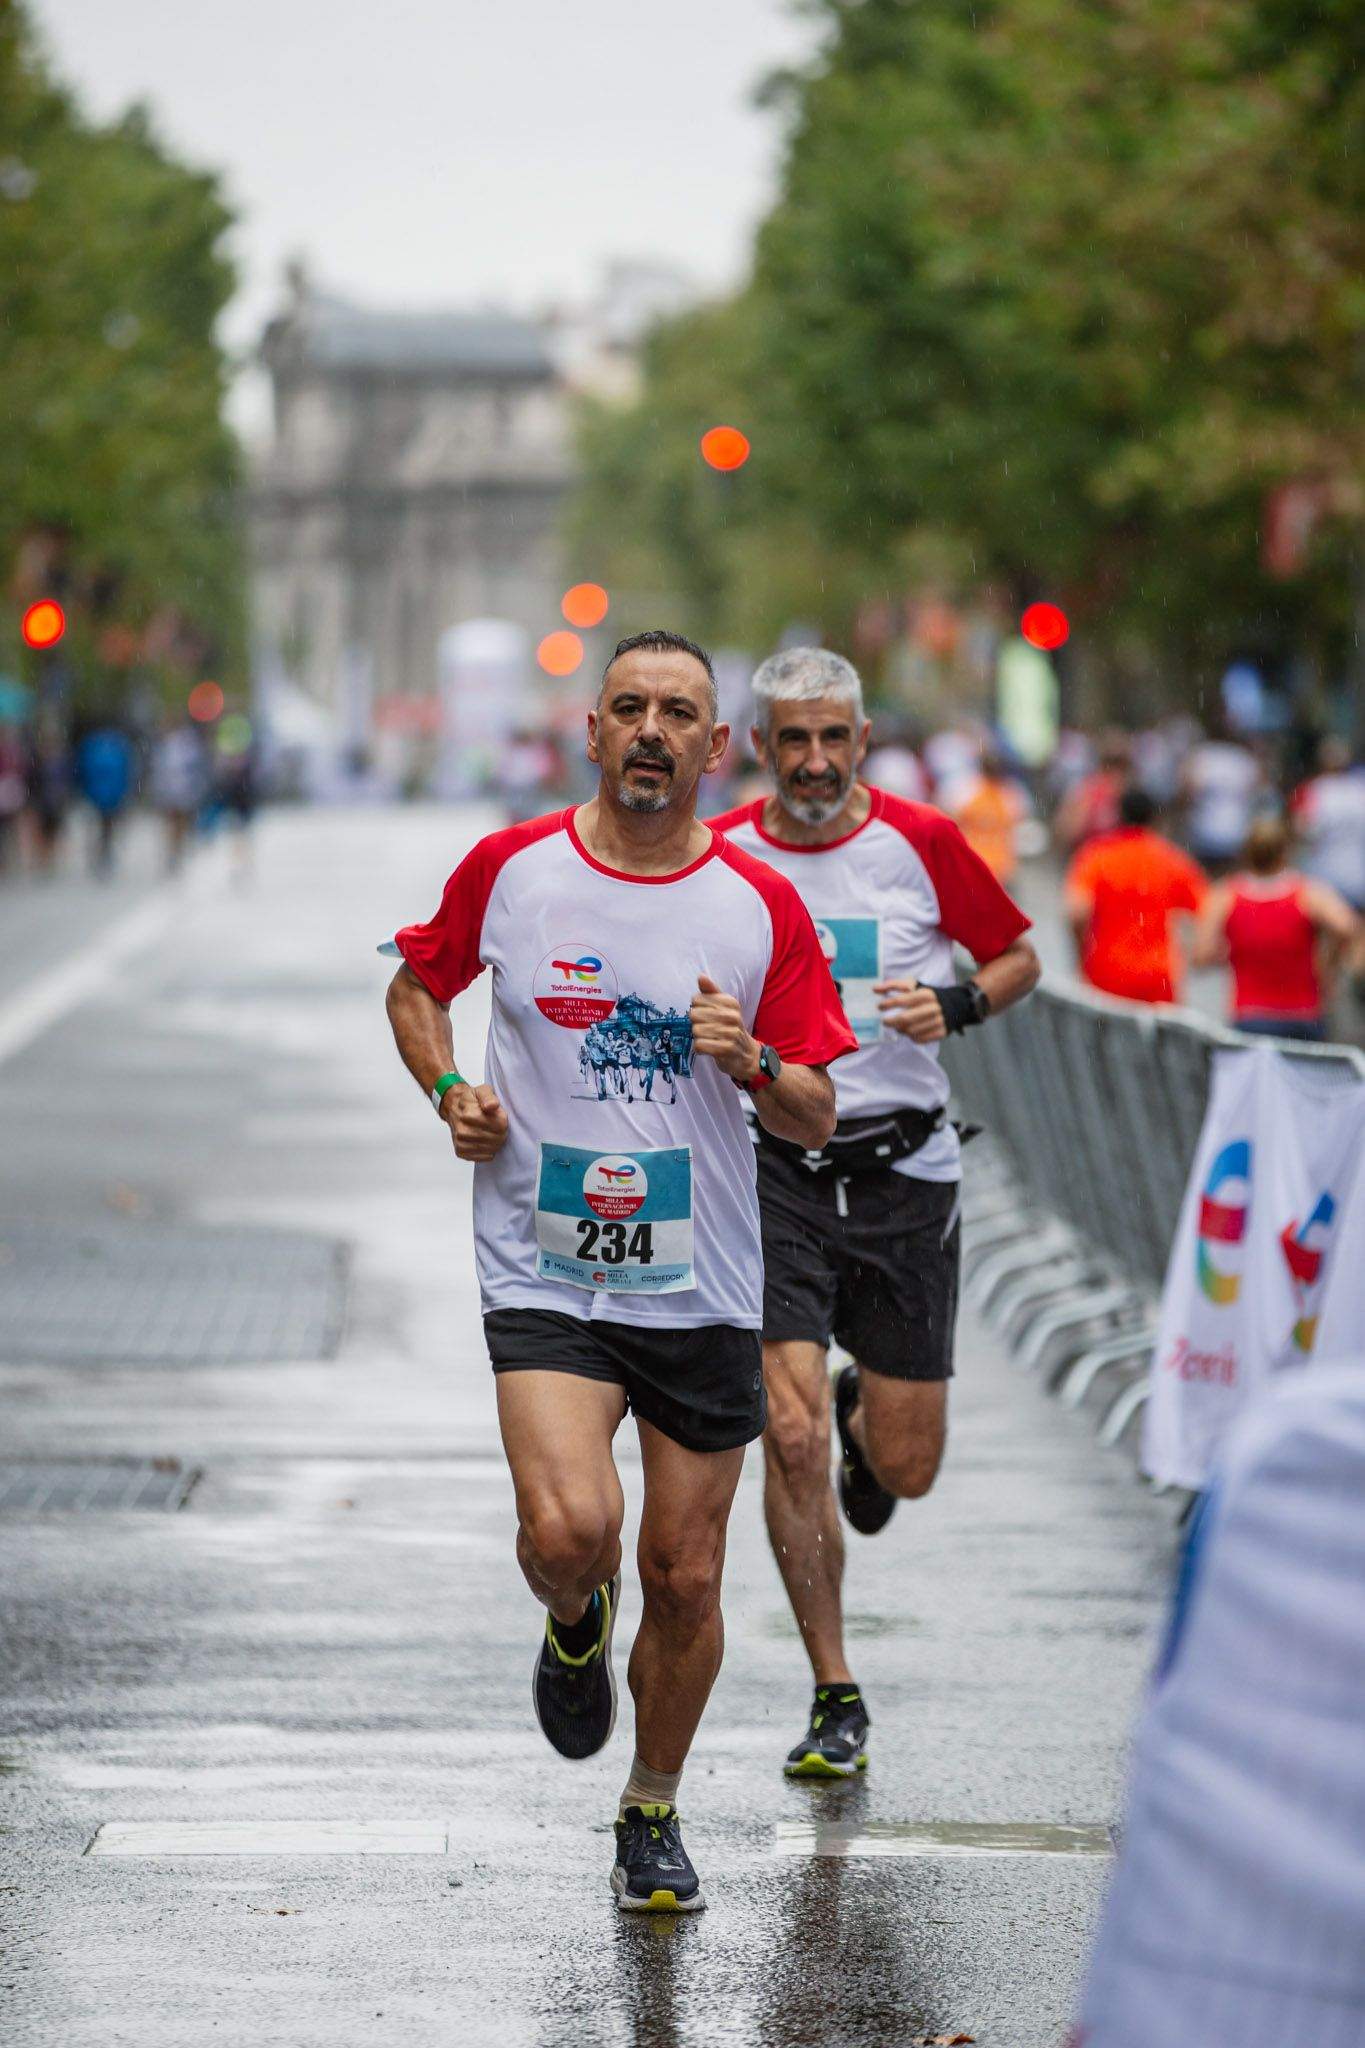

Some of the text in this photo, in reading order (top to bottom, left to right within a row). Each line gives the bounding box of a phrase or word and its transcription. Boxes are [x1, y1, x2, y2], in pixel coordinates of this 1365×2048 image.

[551, 984, 602, 994] TotalEnergies
[597, 1185, 636, 1193] TotalEnergies
[591, 1201, 638, 1210] INTERNACIONAL
[576, 1219, 654, 1265] 234
[554, 1262, 584, 1277] MADRID
